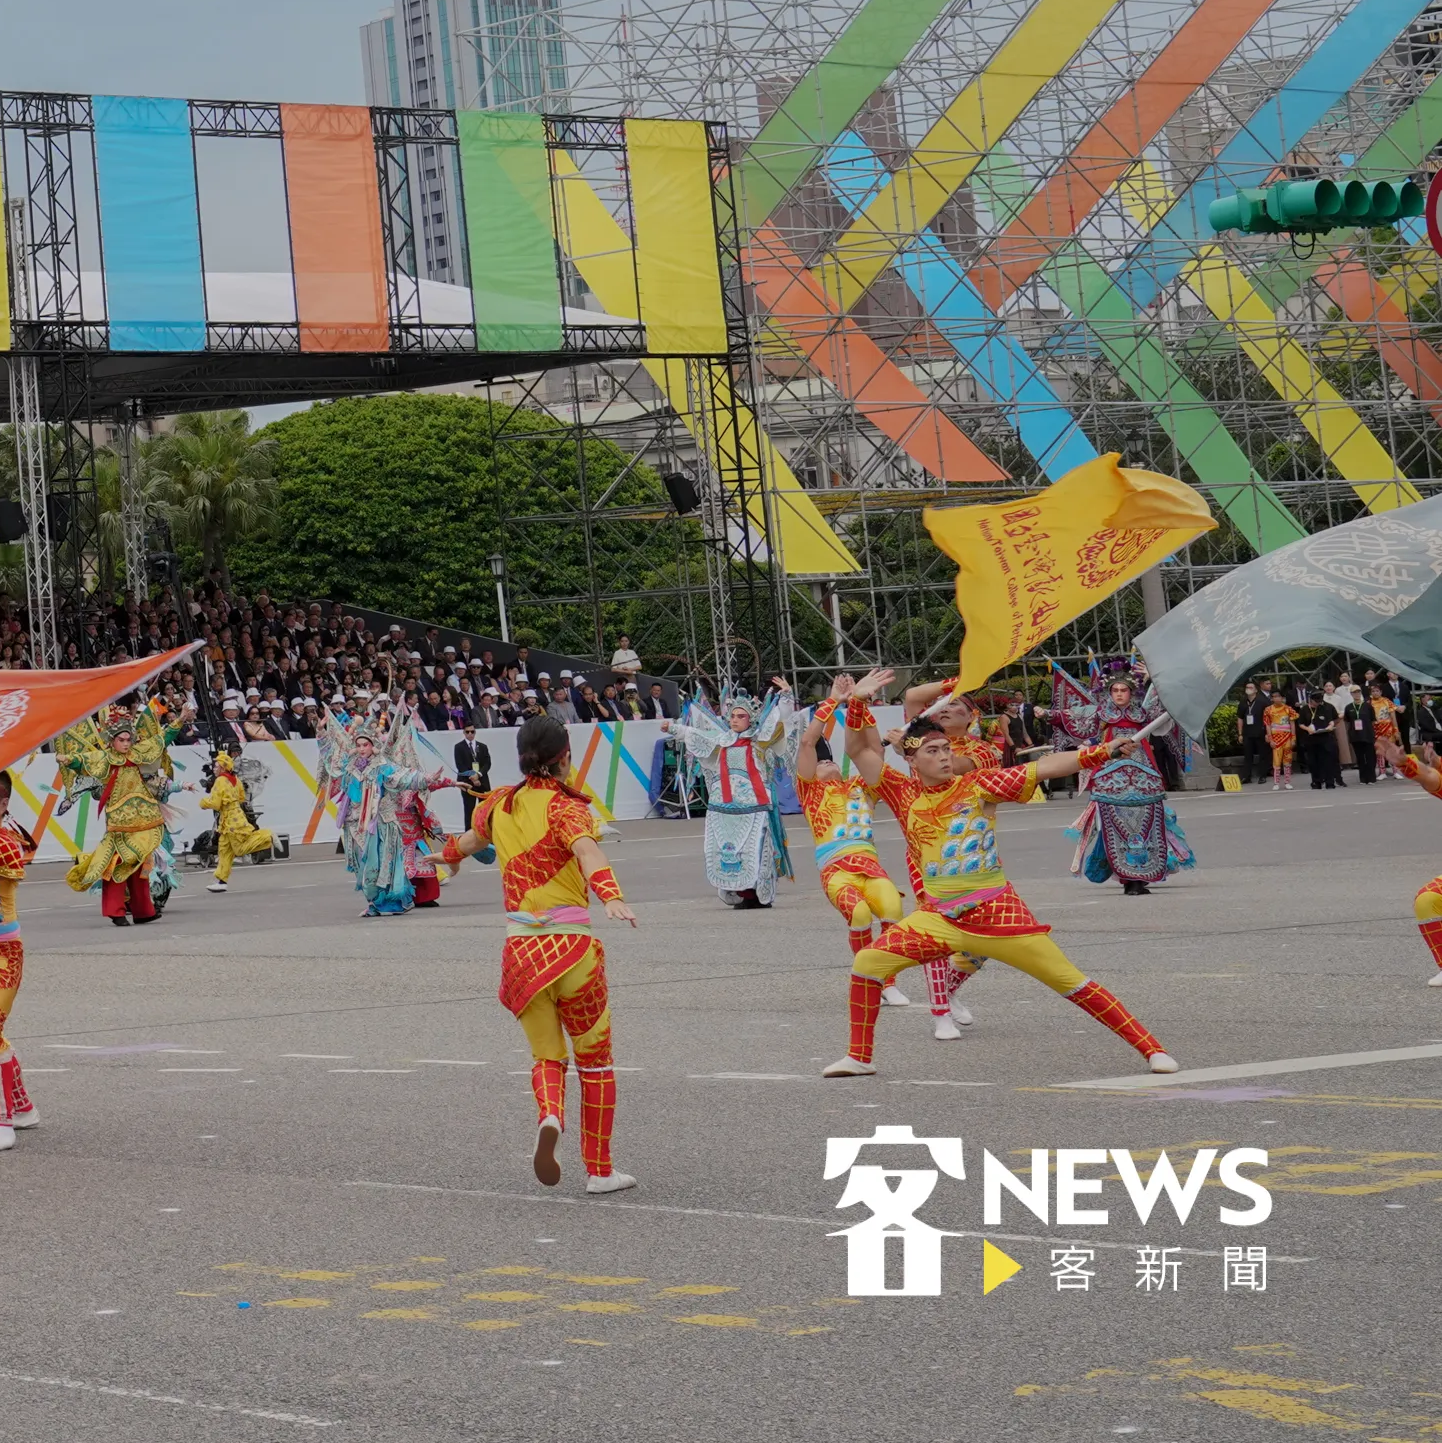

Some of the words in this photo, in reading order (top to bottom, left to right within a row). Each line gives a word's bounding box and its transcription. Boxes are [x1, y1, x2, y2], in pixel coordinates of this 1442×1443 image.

[1005, 576, 1020, 609] College
[1011, 611, 1023, 621] of
[1224, 776, 1239, 790] 50
